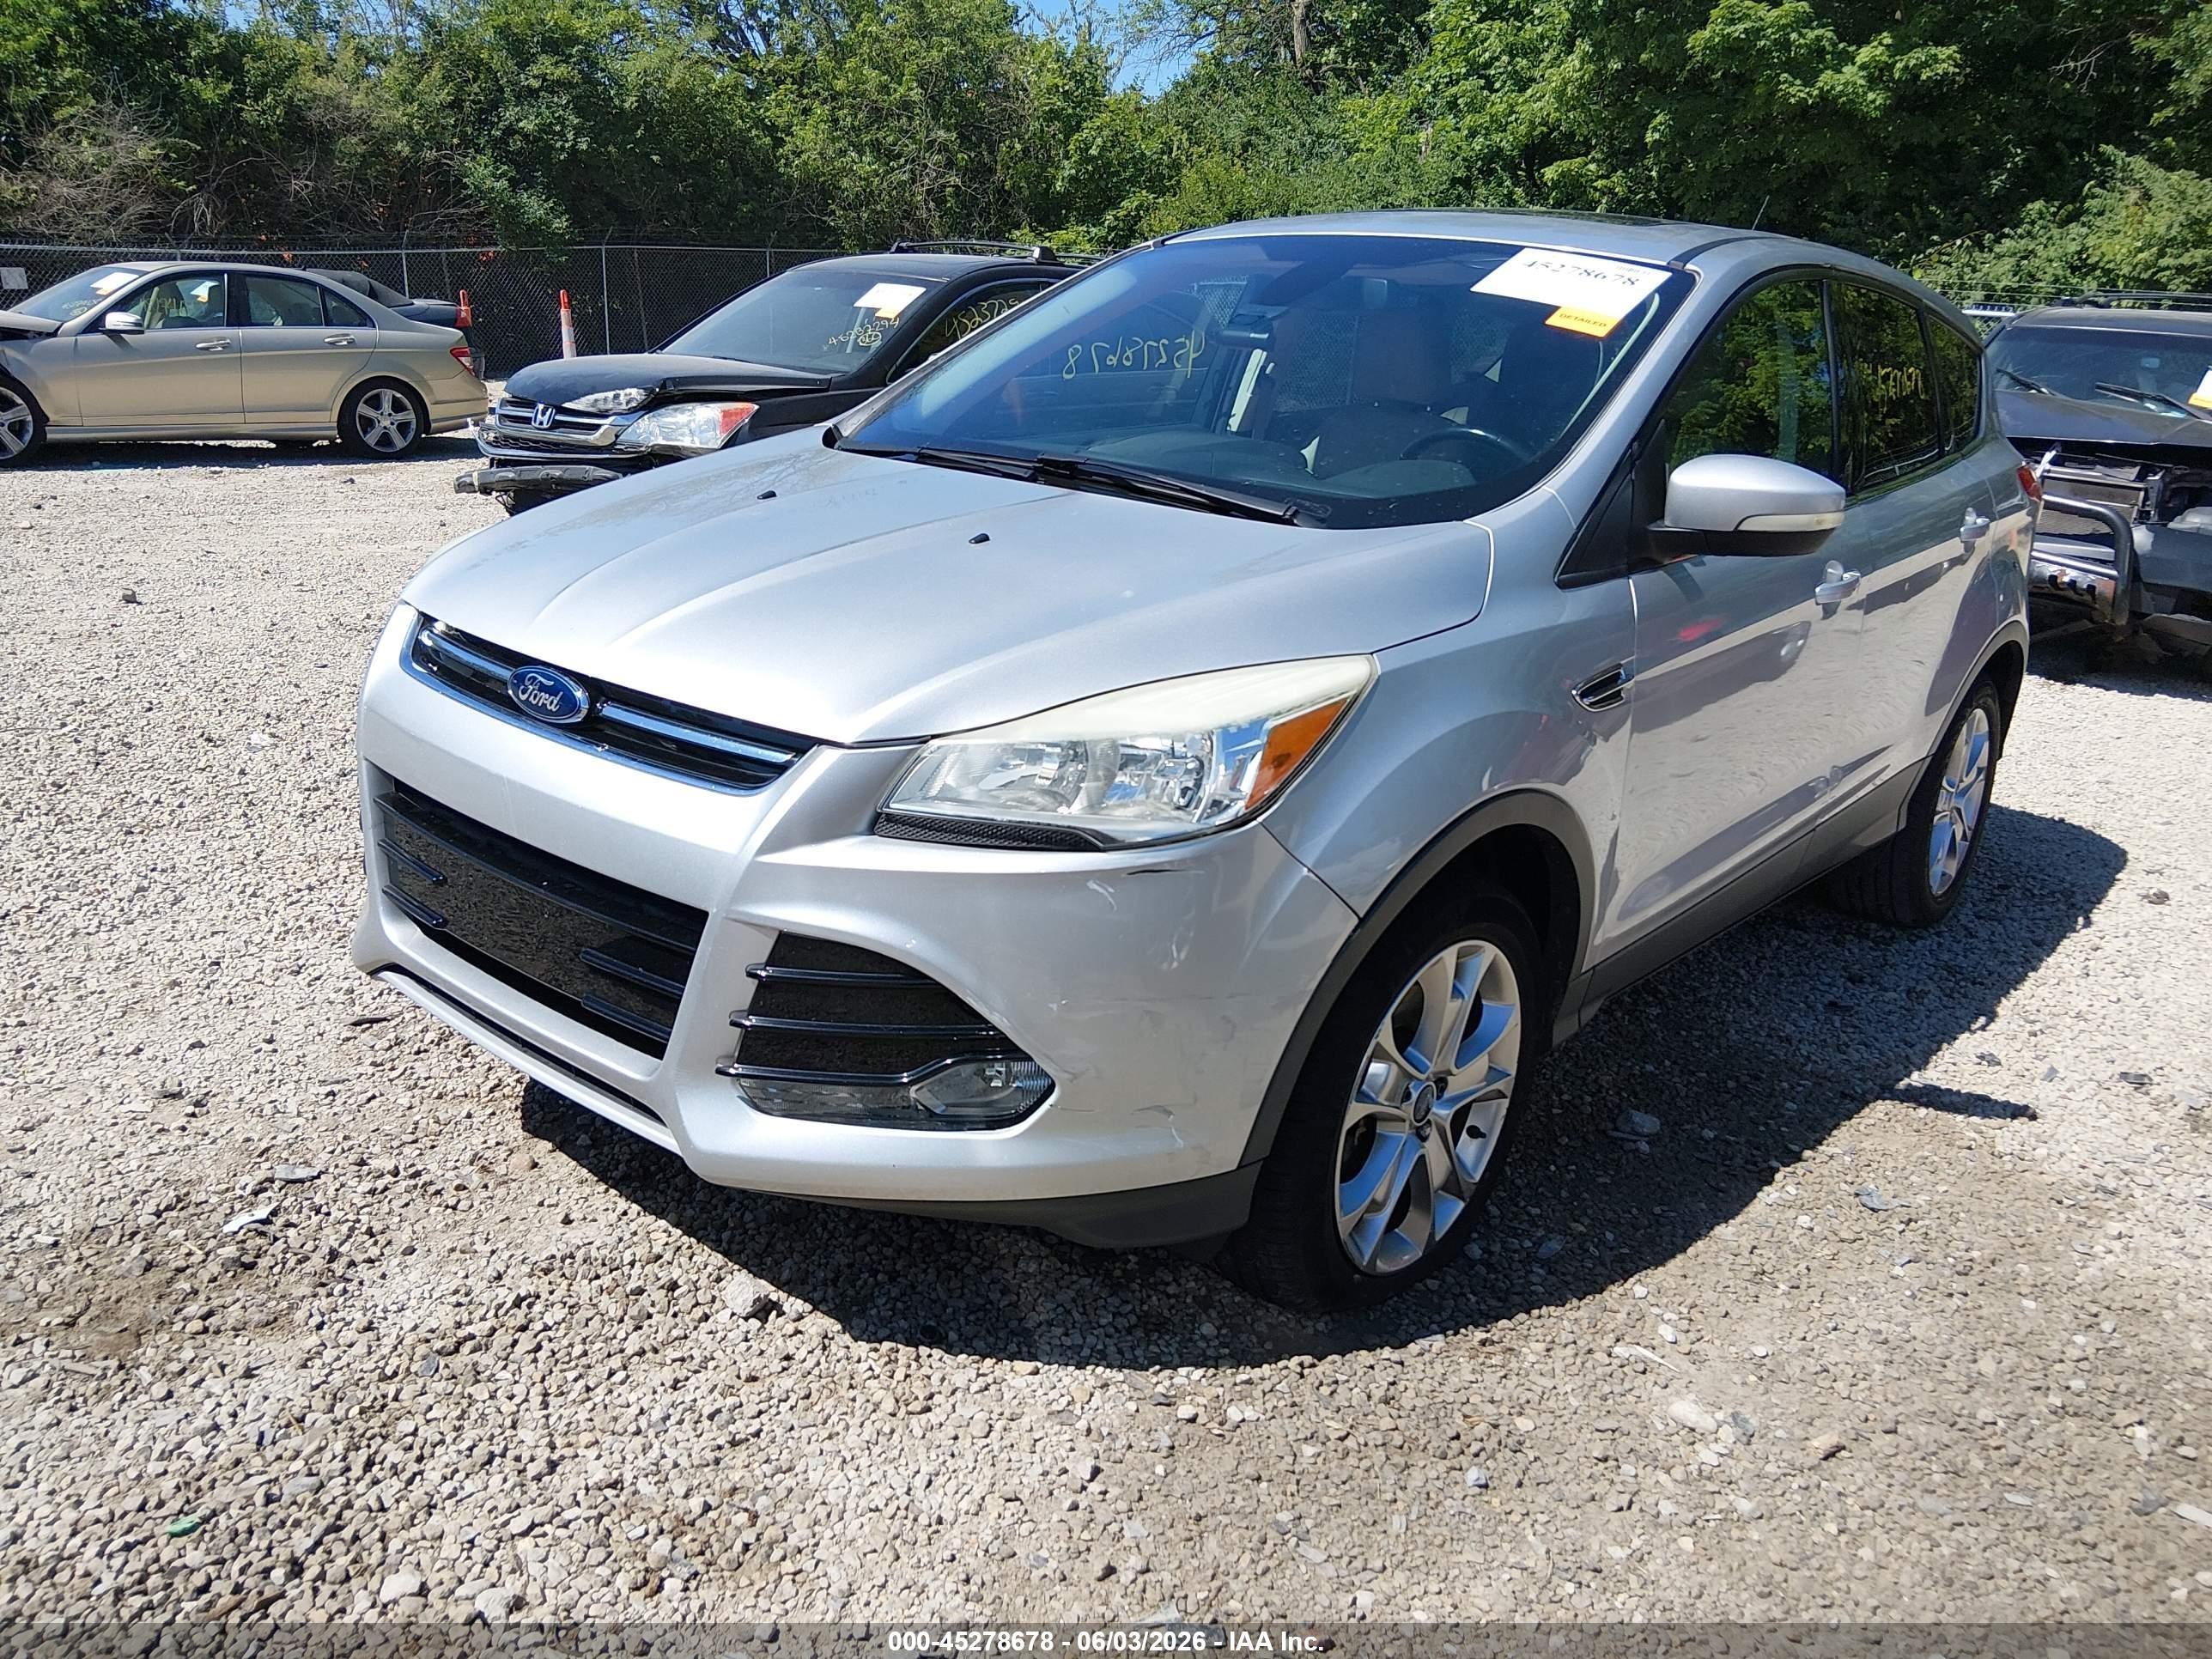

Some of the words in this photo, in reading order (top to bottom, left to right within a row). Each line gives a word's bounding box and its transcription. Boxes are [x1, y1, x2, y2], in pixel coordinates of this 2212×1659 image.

[1522, 259, 1641, 286] 45278678
[1559, 313, 1607, 328] DETAILED
[519, 673, 563, 712] Ford
